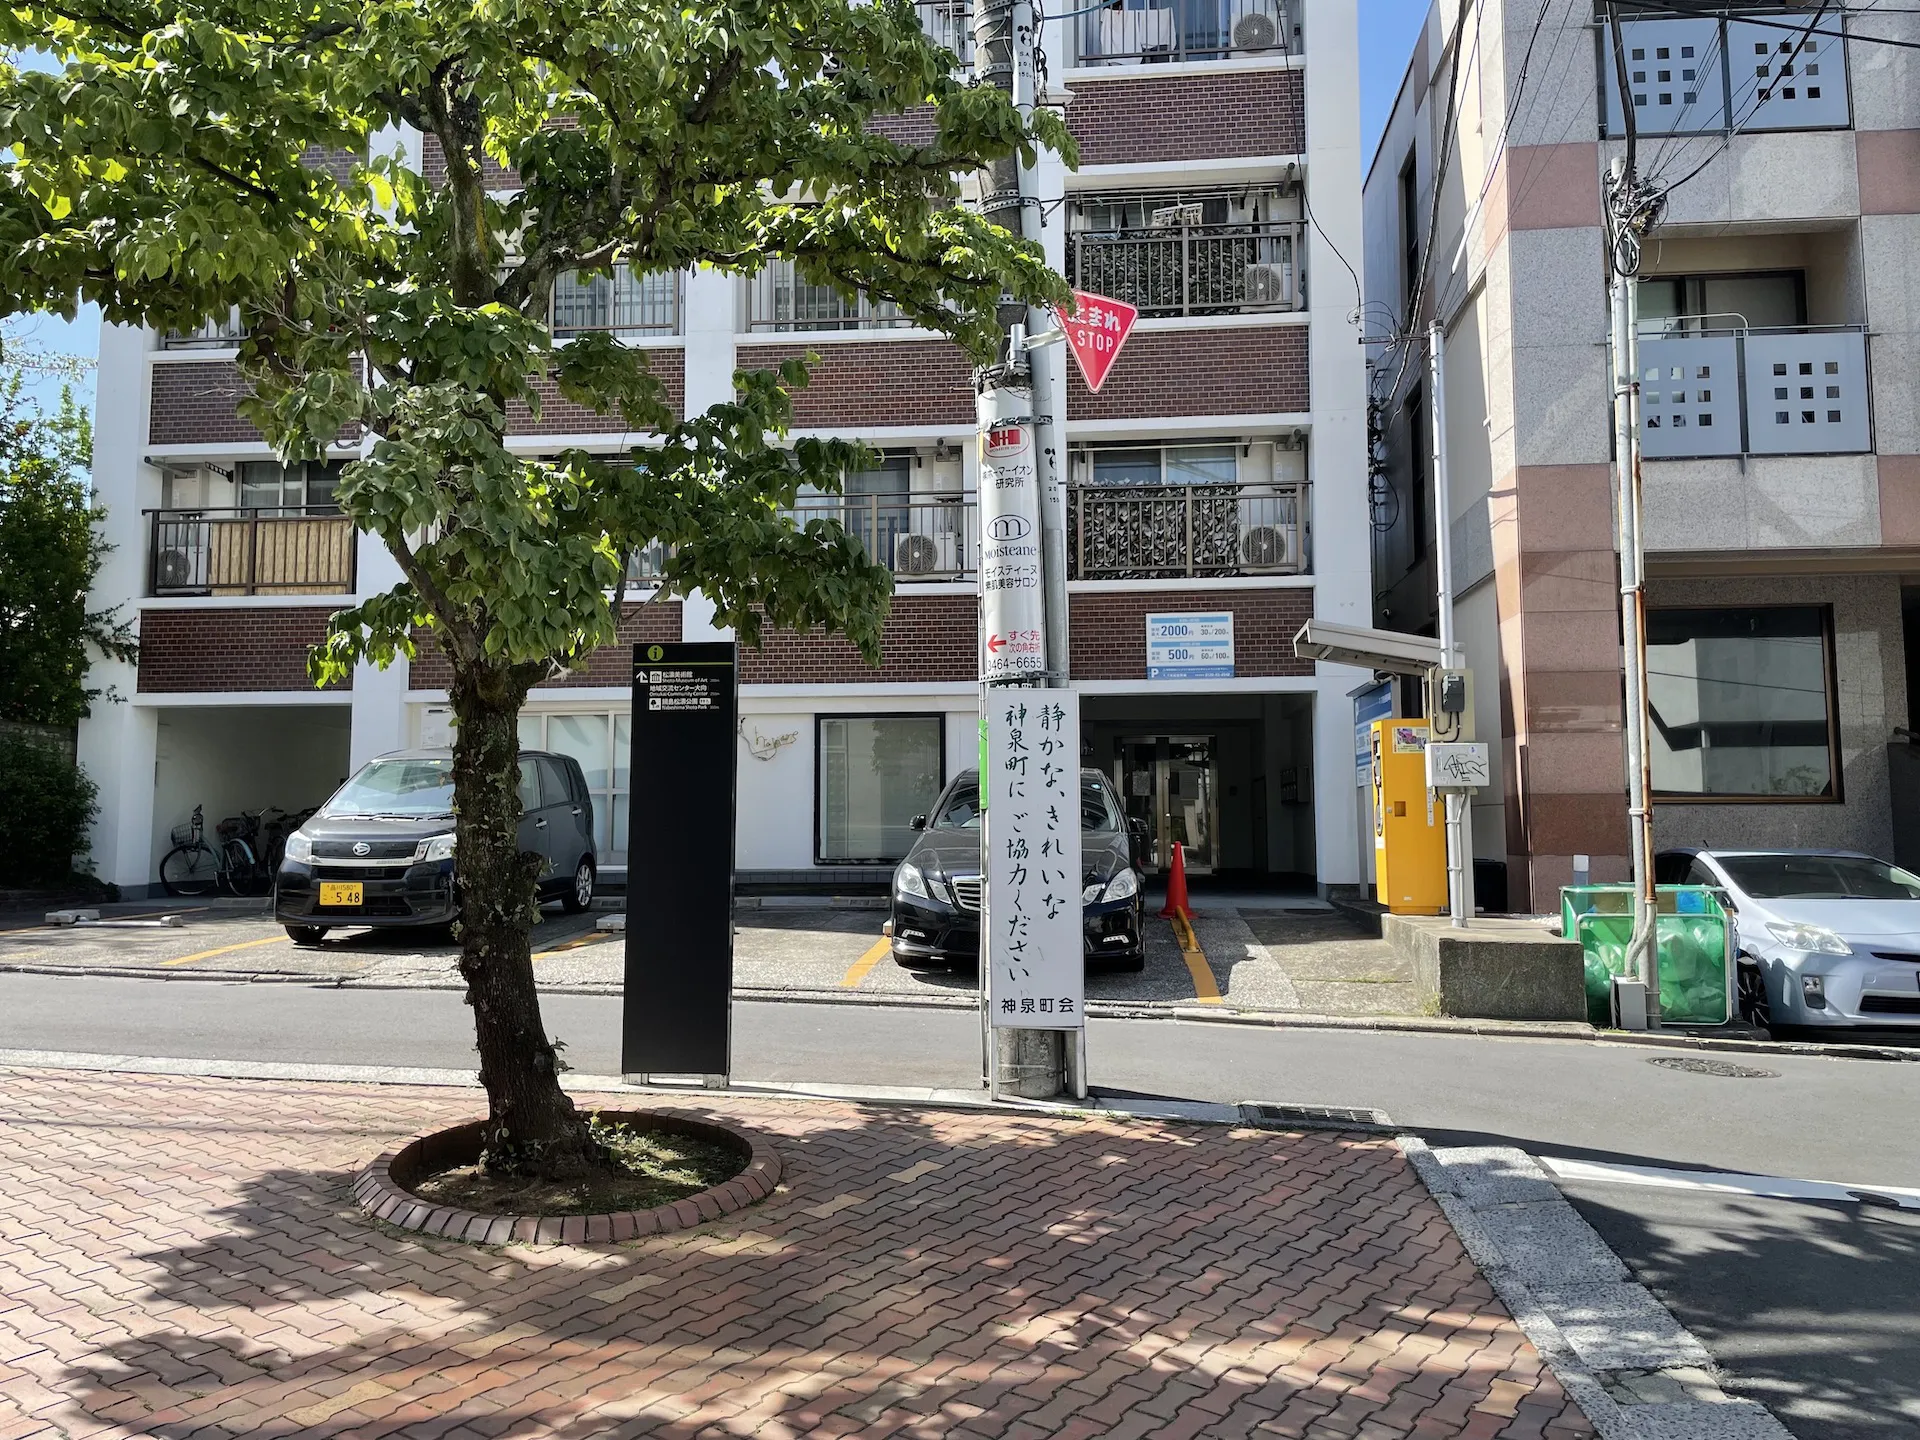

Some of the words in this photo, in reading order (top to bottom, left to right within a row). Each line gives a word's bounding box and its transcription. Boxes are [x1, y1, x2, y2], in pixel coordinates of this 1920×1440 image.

[1077, 329, 1113, 353] STOP
[995, 477, 1025, 489] 研究所
[985, 545, 1037, 560] Moisteane
[985, 564, 1037, 578] モイスティーヌ
[985, 577, 1038, 591] 素肌美容サロン
[1008, 630, 1040, 641] すぐ先
[1009, 642, 1041, 653] 次の角右折
[987, 656, 1042, 671] 3464-6655
[1151, 668, 1159, 678] P
[1036, 704, 1067, 920] 静かな、きれいな
[347, 892, 360, 903] 48
[1001, 997, 1074, 1014] 神泉町会
